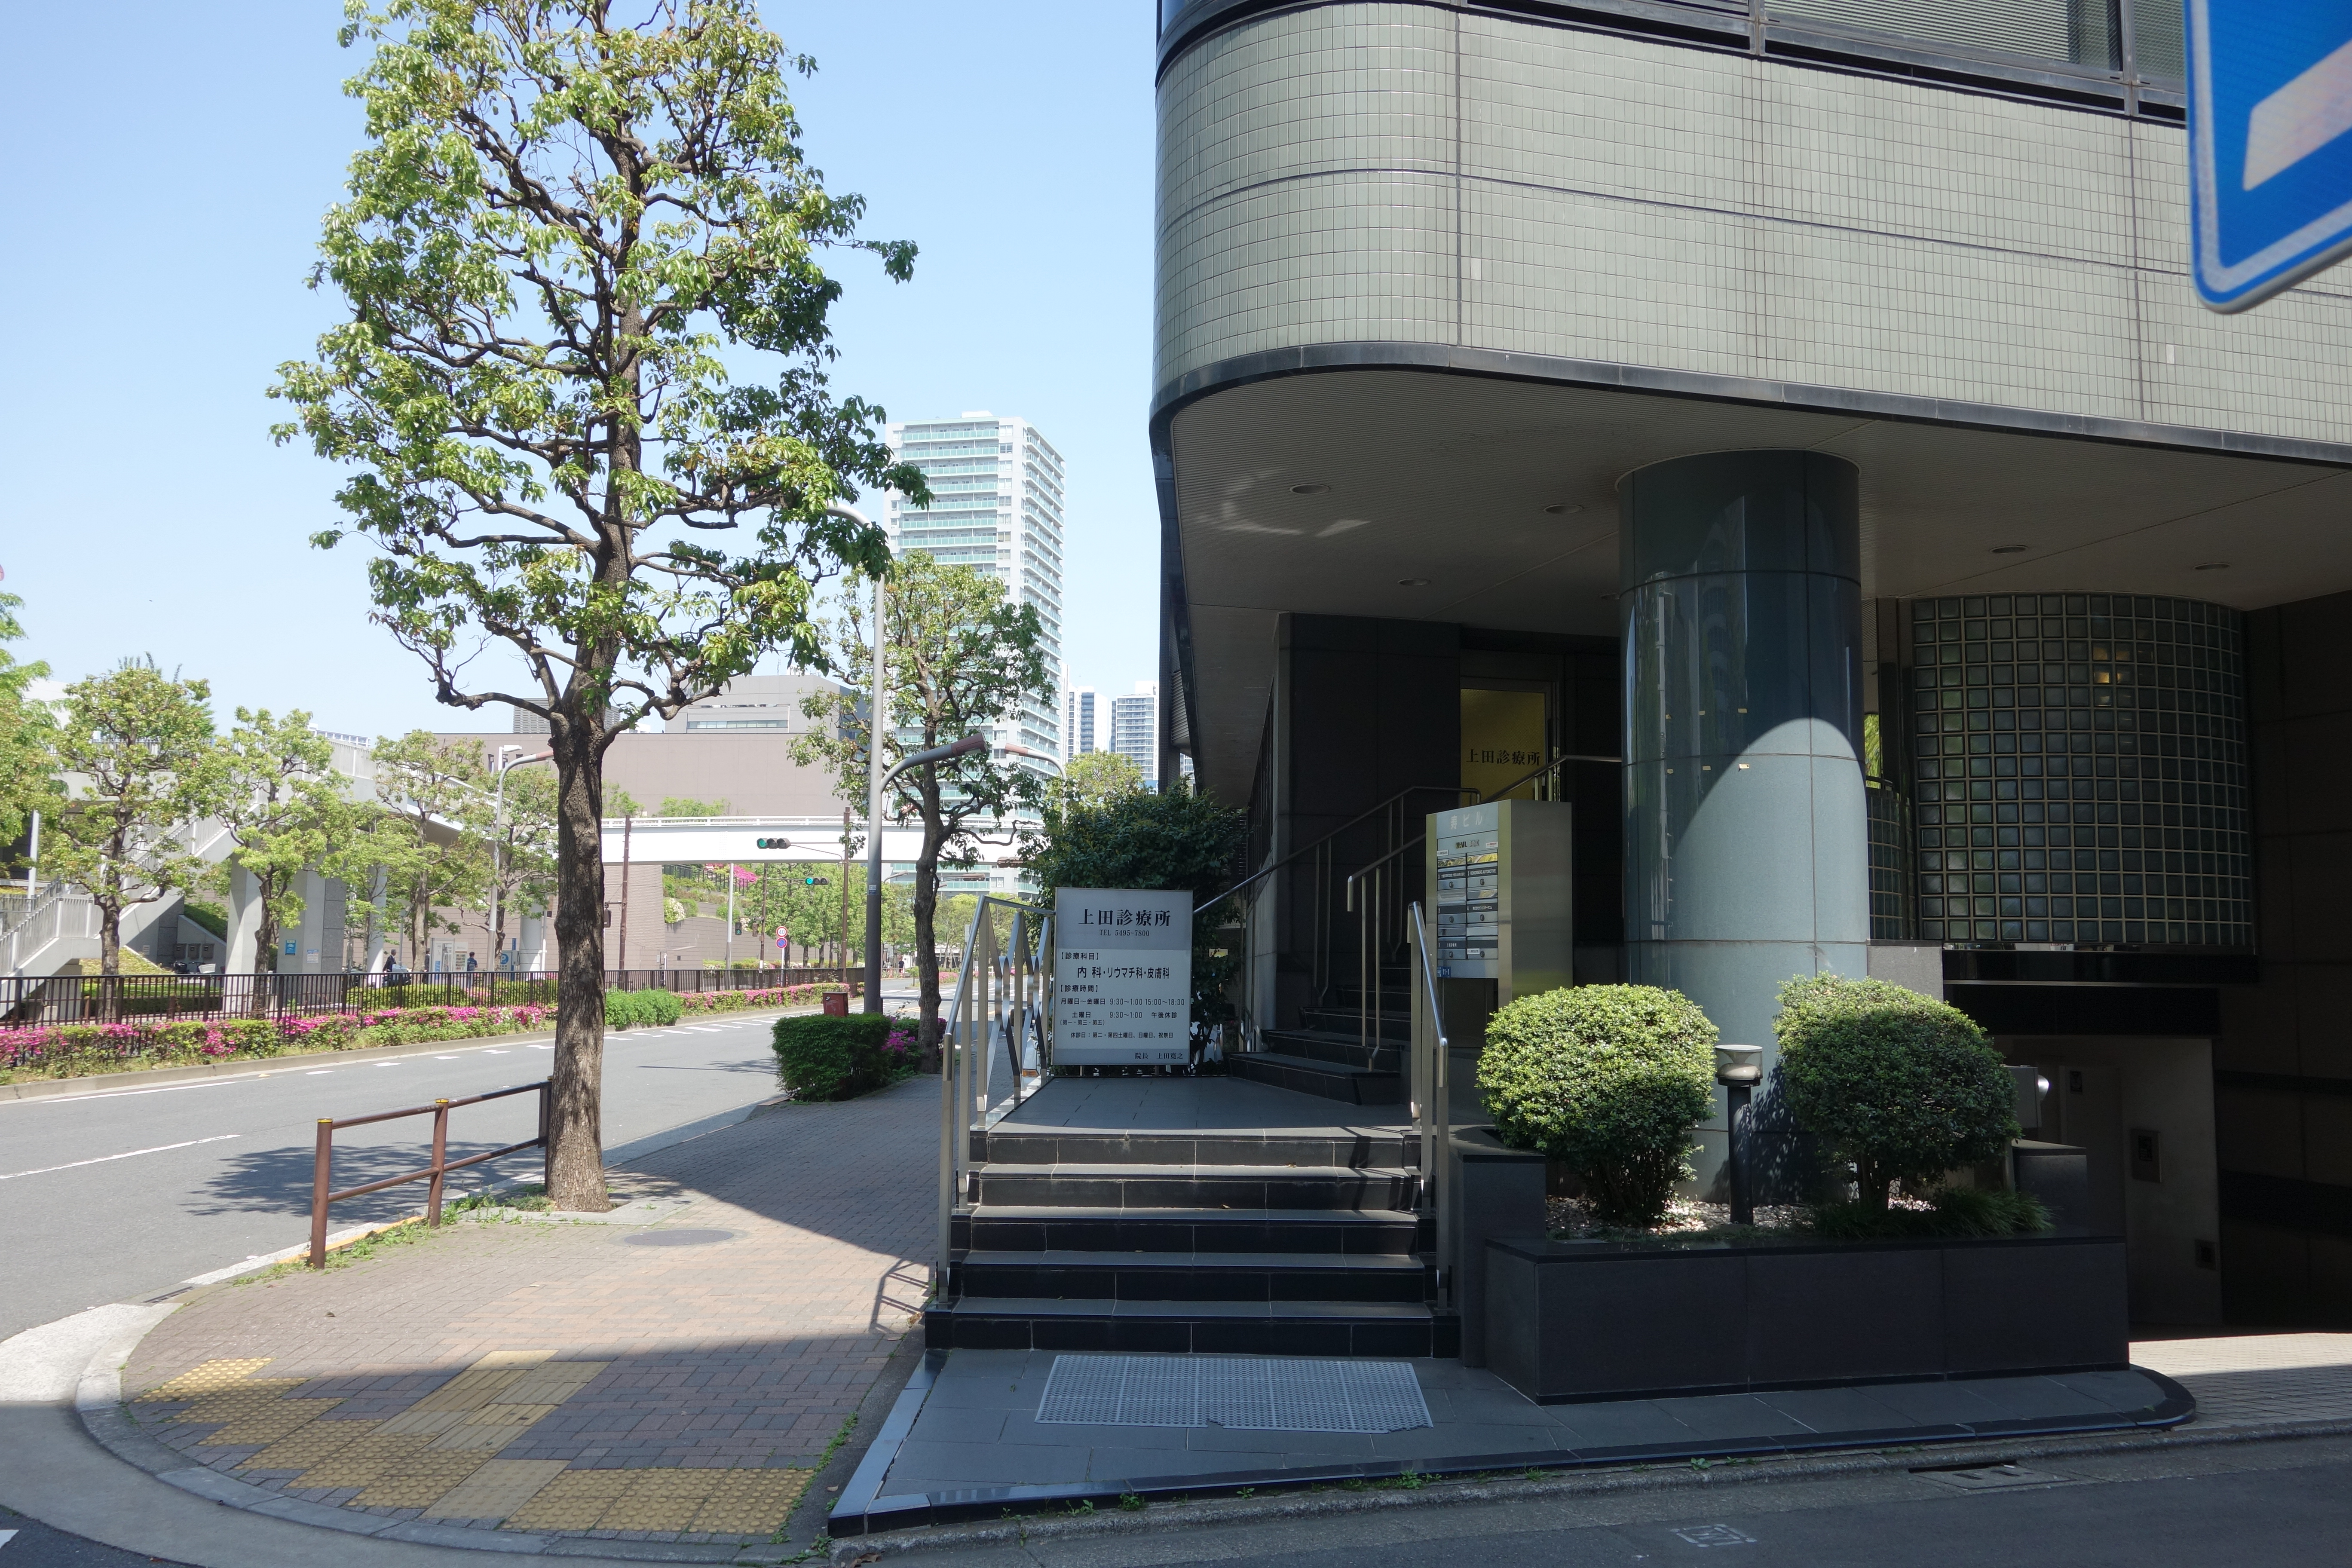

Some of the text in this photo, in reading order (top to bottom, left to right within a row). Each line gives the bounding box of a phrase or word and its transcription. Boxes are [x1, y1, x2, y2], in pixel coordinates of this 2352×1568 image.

[1466, 749, 1540, 766] 上田診療所
[1451, 811, 1482, 830] 寿ビル
[1078, 908, 1171, 927] 上田診療所
[1061, 952, 1099, 960] 【診療科目】
[1060, 984, 1098, 992] 【診療時間】
